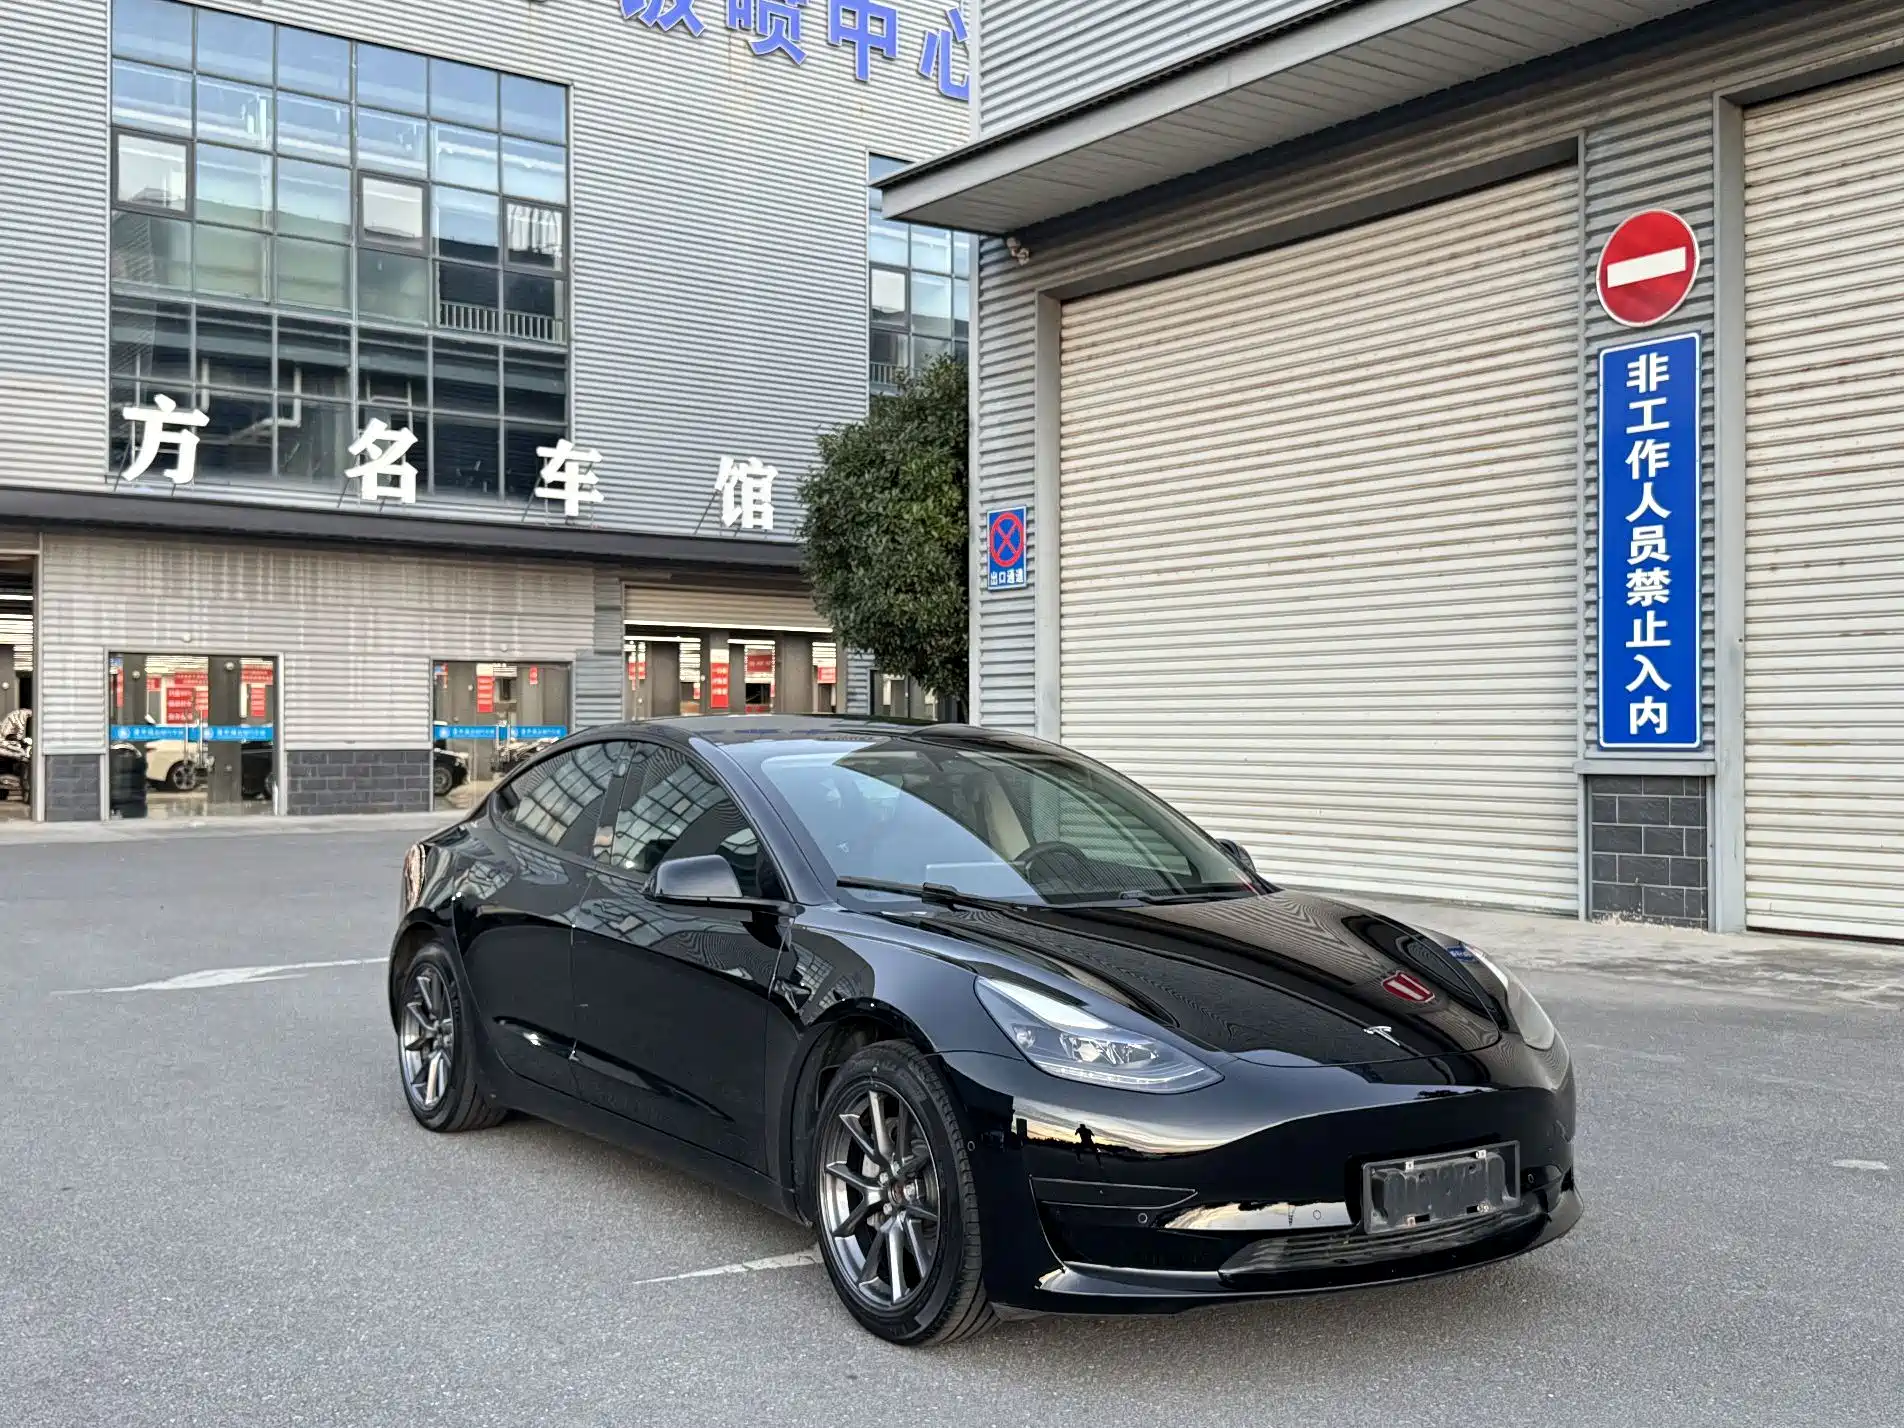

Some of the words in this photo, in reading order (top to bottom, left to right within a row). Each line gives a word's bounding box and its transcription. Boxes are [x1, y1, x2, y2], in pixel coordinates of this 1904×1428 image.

[122, 394, 779, 530] 方名车馆
[1626, 352, 1671, 735] 非工作人员禁止入内
